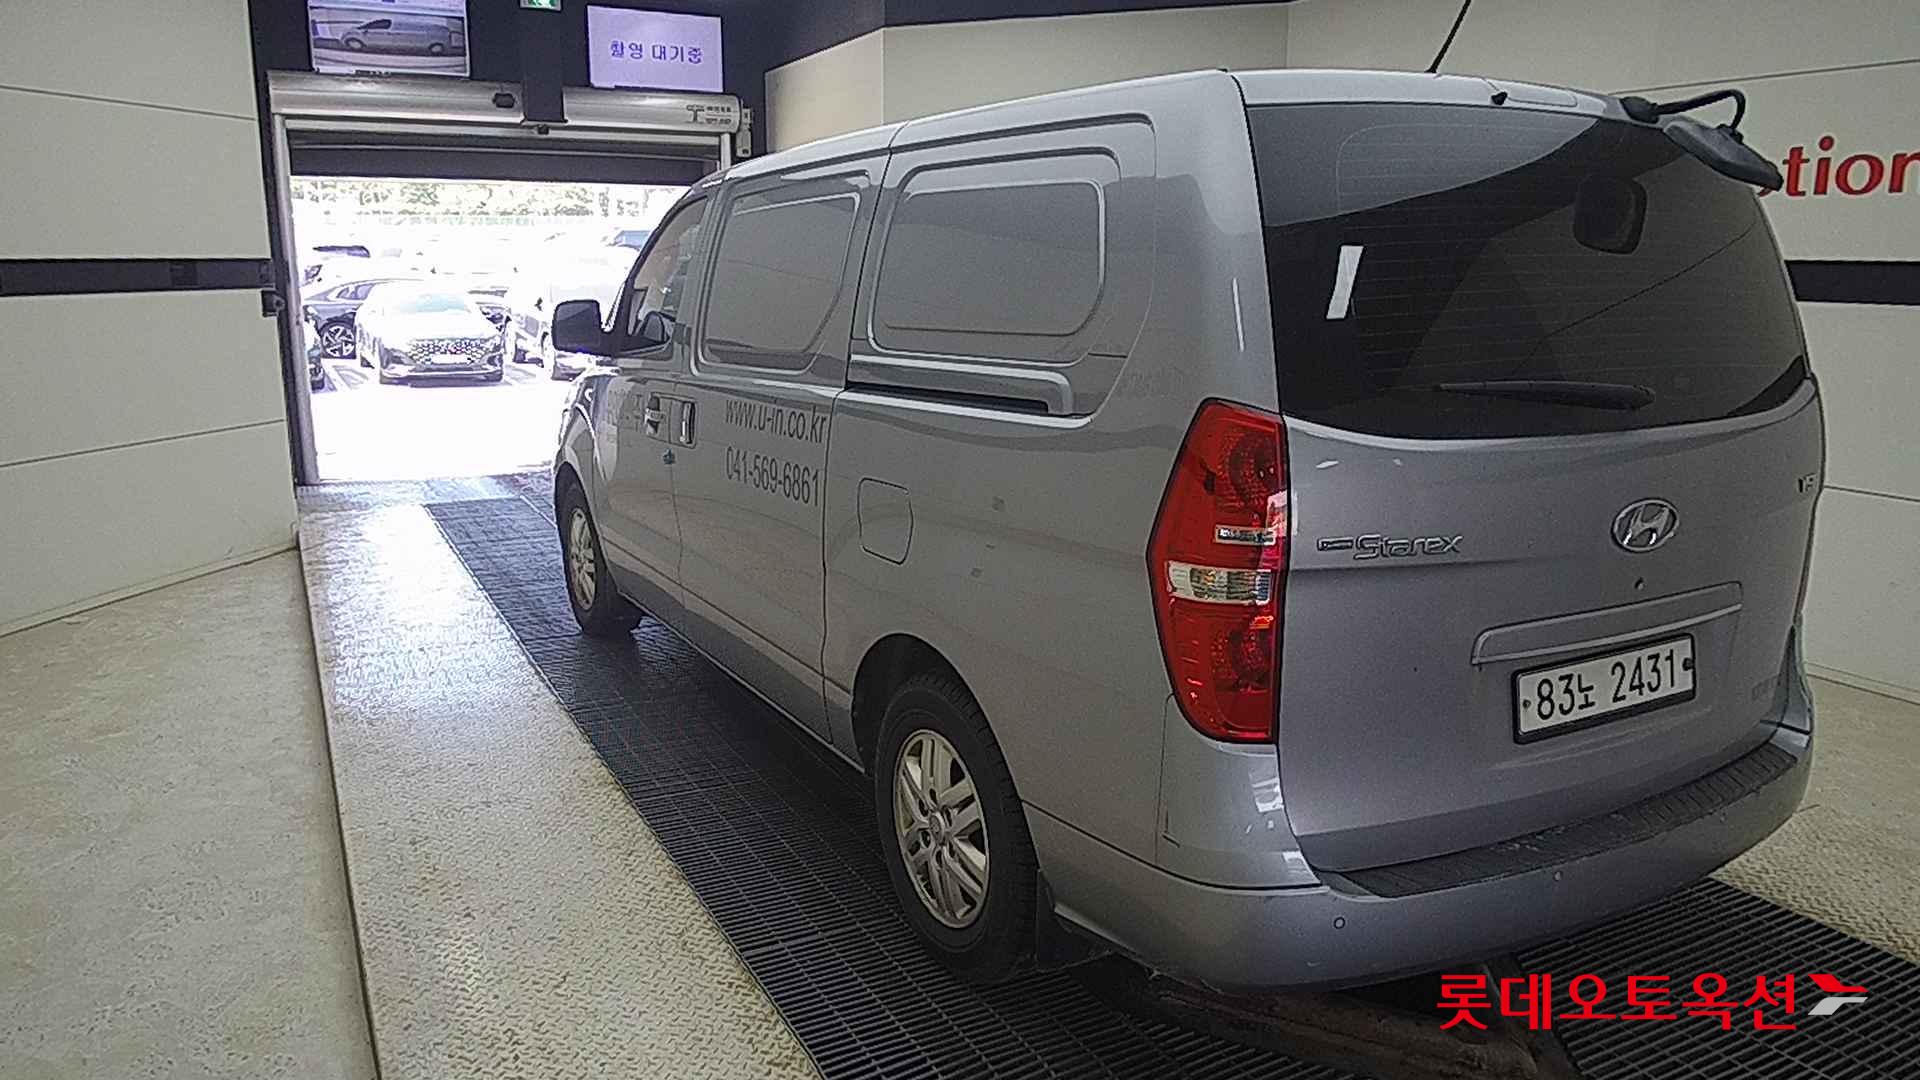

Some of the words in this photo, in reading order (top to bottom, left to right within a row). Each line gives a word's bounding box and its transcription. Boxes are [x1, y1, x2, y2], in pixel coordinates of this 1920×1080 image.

[651, 43, 702, 64] 대기중
[1758, 136, 1920, 197] tion
[726, 446, 820, 507] 041-569-6861
[1354, 534, 1463, 560] Starex
[1537, 673, 1595, 720] 83노
[1611, 648, 1675, 703] 2431
